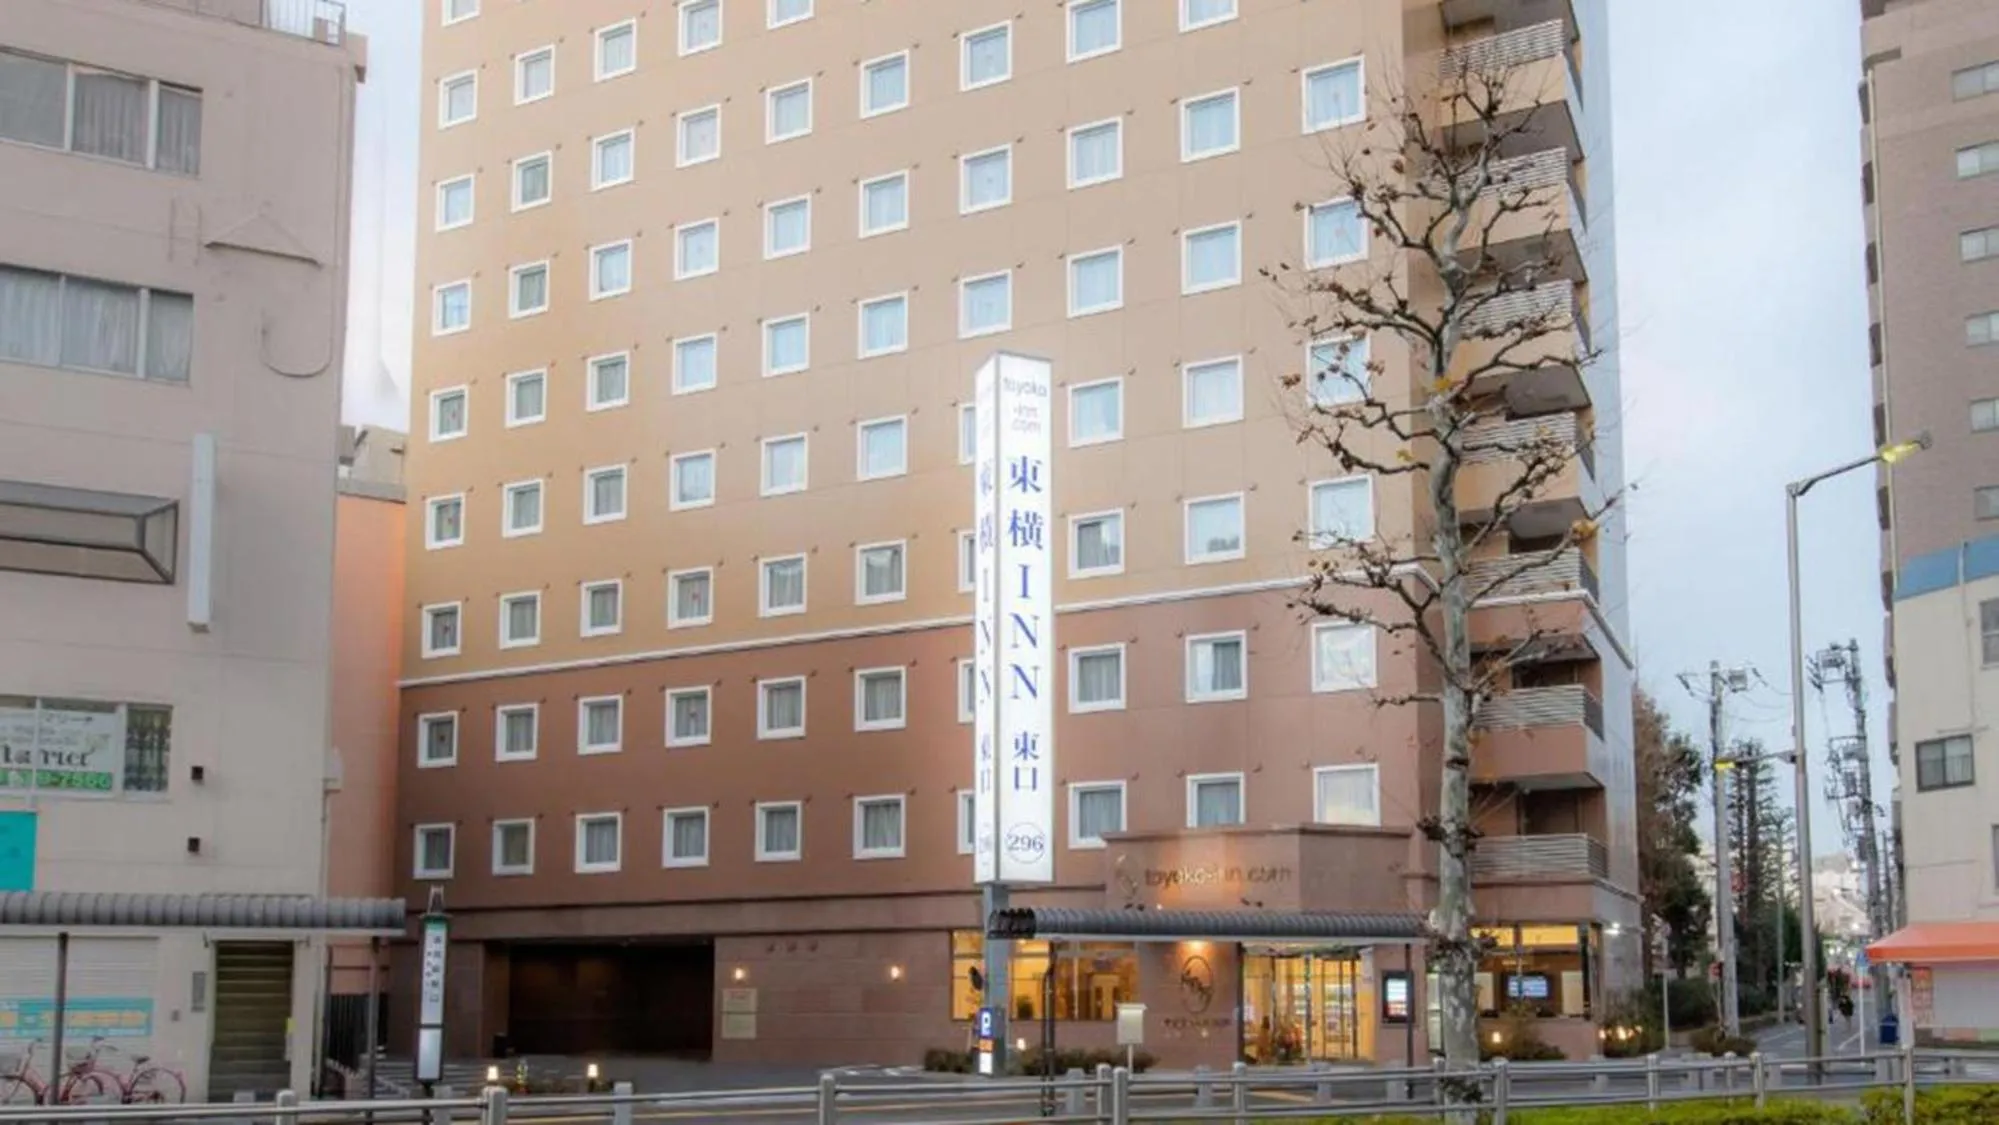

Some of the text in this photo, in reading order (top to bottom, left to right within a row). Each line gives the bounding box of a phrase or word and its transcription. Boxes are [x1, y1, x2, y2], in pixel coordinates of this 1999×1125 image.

[1003, 376, 1047, 397] toyoko
[1008, 456, 1044, 791] 東横INN 東口
[1006, 834, 1044, 851] 296
